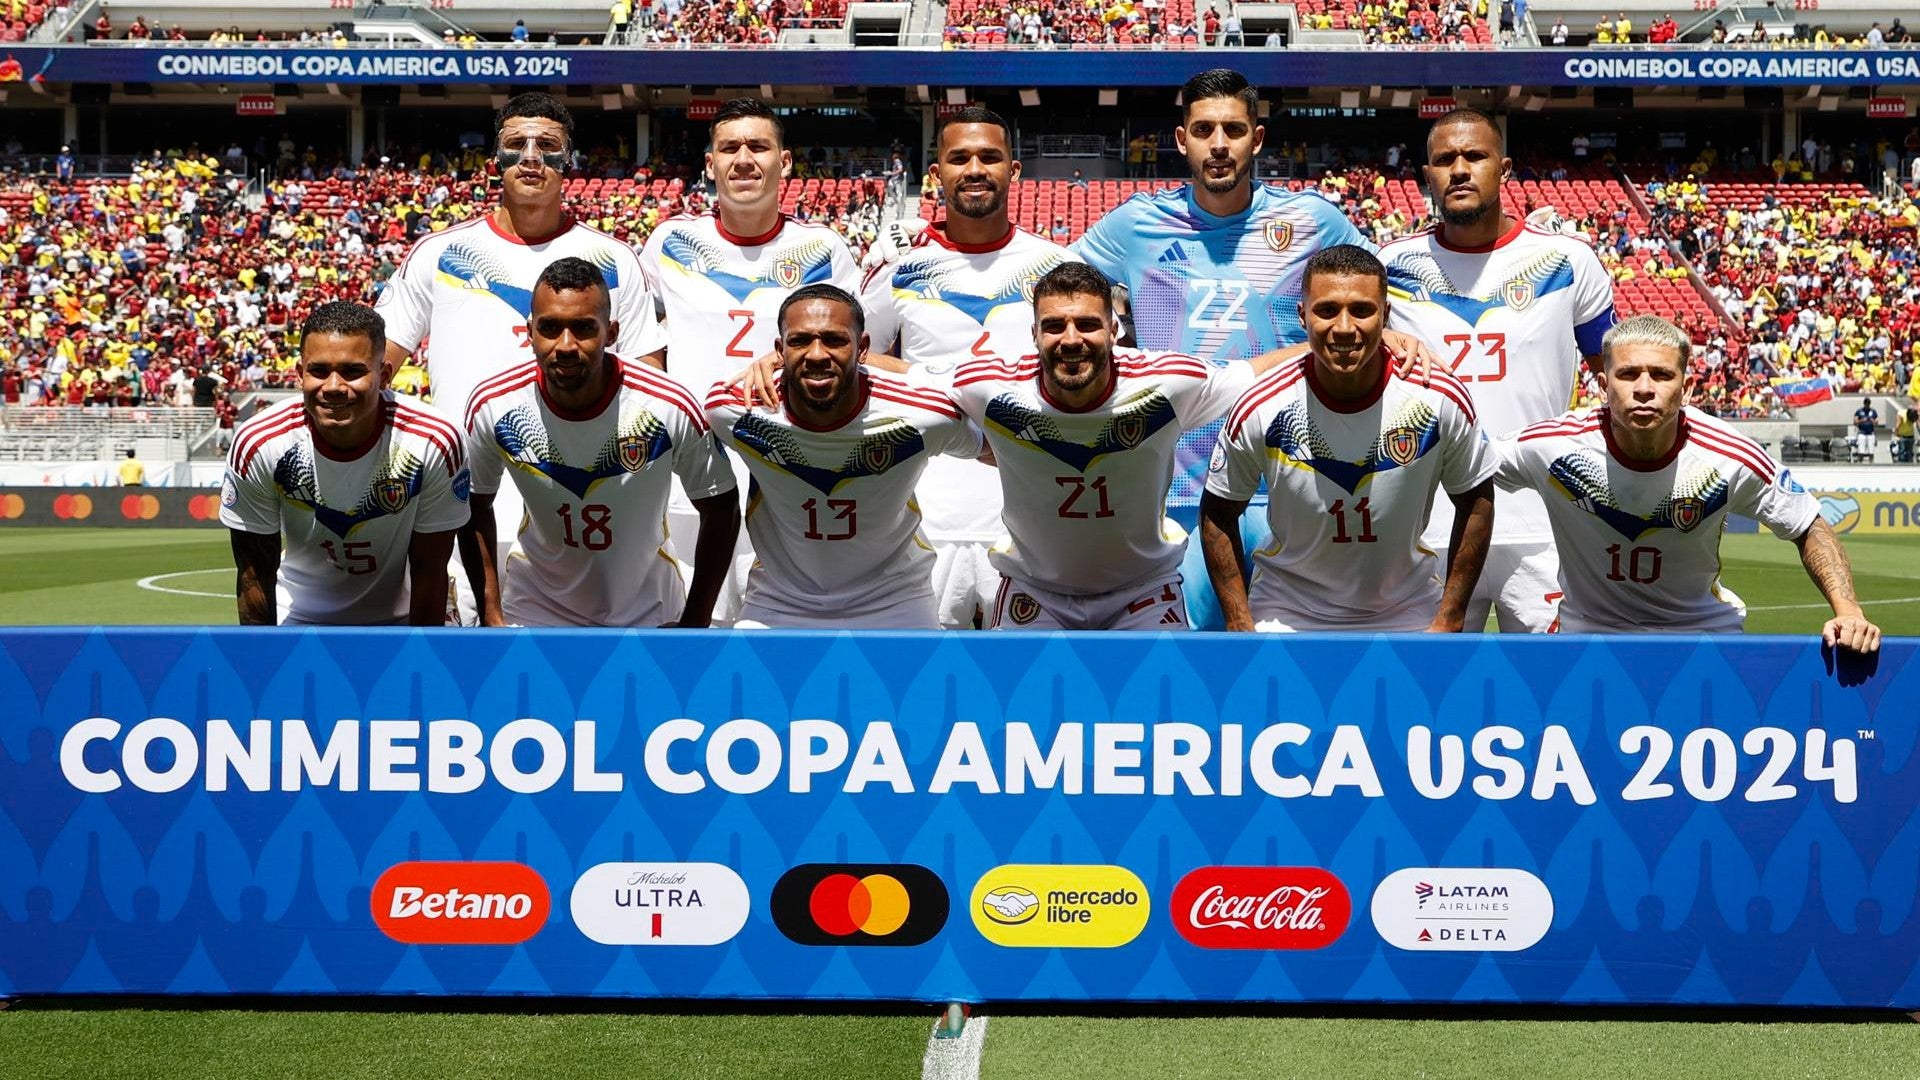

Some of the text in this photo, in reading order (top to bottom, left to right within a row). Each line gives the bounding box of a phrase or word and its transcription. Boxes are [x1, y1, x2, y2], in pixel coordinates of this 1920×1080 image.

[158, 55, 569, 77] CONMEBOL COPA AMERICA USA 2024
[1564, 57, 1920, 78] CONMEBOL COPA AMERICA USA
[1188, 279, 1249, 330] 22
[725, 310, 755, 358] 2
[1443, 332, 1507, 383] 23
[1055, 475, 1115, 519] 21
[556, 503, 613, 551] 18
[800, 497, 857, 541] 13
[1328, 497, 1378, 544] 11
[320, 539, 377, 575] 15
[1605, 543, 1662, 585] 10
[59, 717, 624, 794] CONMEBOL
[643, 718, 916, 795] COPA
[927, 721, 1385, 799] AMERICA
[1407, 724, 1598, 806] USA
[1619, 725, 1859, 804] 2024
[627, 871, 687, 886] Michelob
[1047, 888, 1138, 905] mercado
[1439, 886, 1509, 898] LATAM
[389, 886, 532, 919] Betano
[615, 889, 703, 908] ULTRA
[1047, 906, 1092, 924] libre
[1189, 885, 1331, 930] Coca-Cola
[1438, 902, 1509, 911] AIRLINES
[1440, 928, 1507, 941] DELTA
